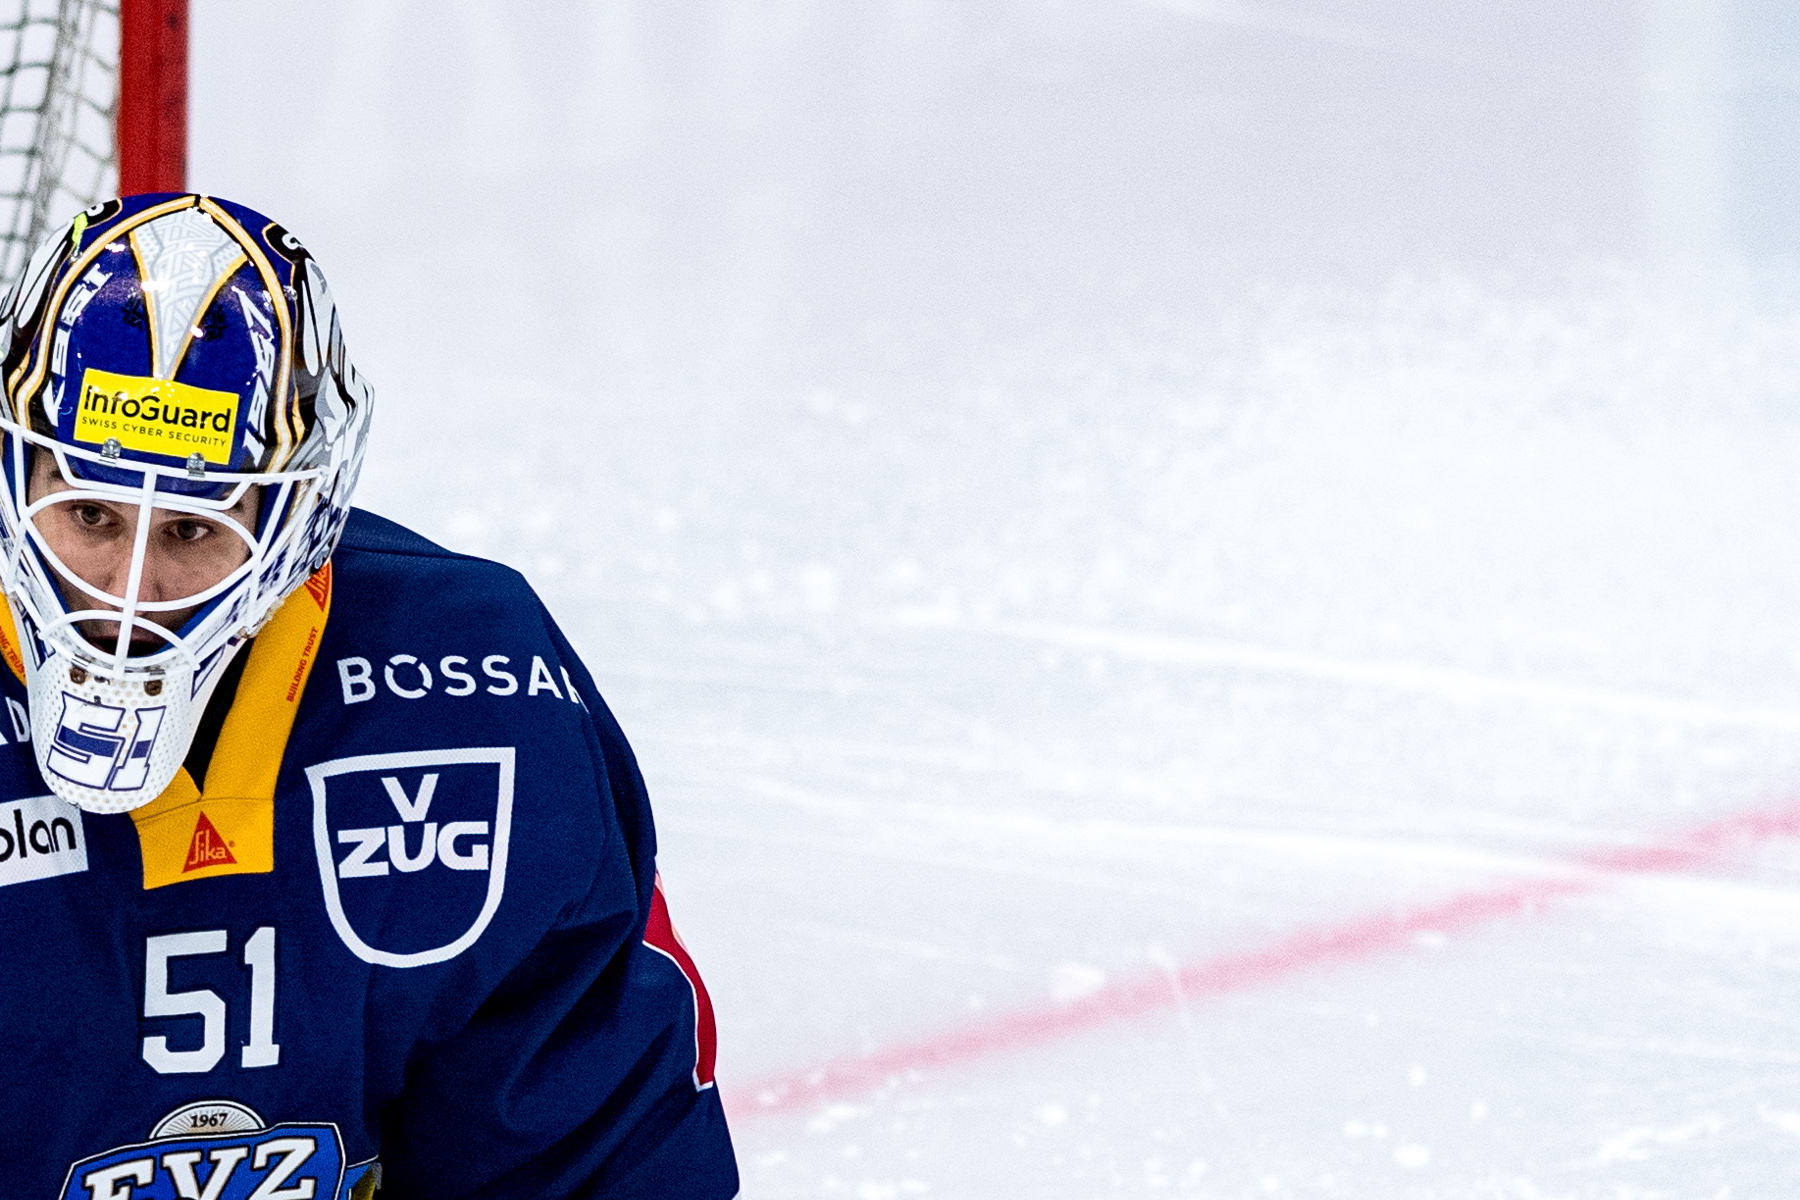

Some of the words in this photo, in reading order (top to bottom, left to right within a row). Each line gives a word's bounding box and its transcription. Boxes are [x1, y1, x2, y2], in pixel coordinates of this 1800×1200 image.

[81, 416, 118, 430] SWISS
[123, 422, 163, 438] CYBER
[168, 430, 228, 448] SECURITY
[83, 384, 232, 434] InfoGuard
[285, 659, 307, 703] BUILDING
[302, 626, 319, 658] TRUST
[46, 691, 167, 792] 51
[381, 773, 440, 822] V
[188, 829, 228, 866] Sika
[338, 820, 490, 879] ZUG
[142, 926, 280, 1074] 51
[190, 1112, 228, 1128] 1967
